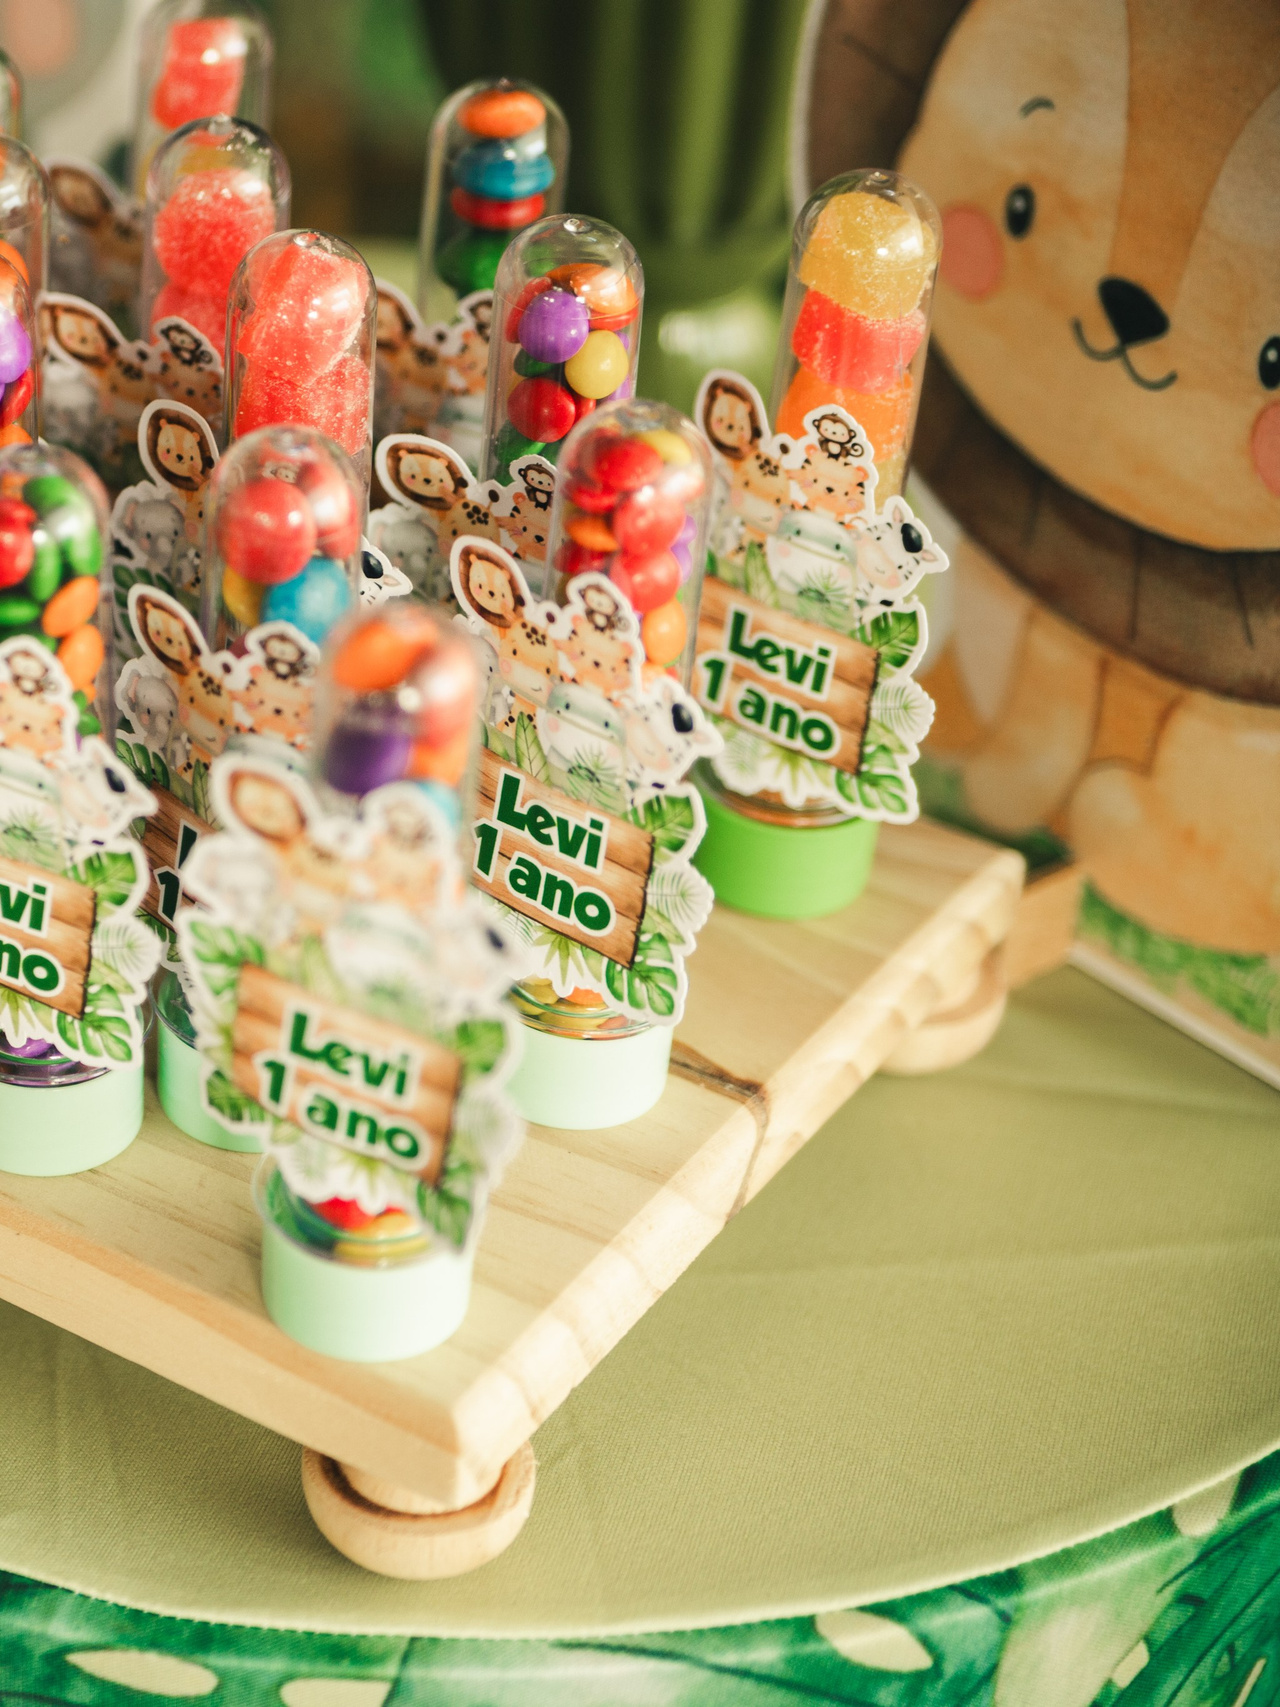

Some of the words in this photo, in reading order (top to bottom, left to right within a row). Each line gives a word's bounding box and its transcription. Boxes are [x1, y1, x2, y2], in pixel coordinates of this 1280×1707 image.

[729, 610, 830, 693] Levi
[703, 658, 725, 702] 1
[739, 688, 833, 751] ano
[497, 773, 604, 869] Levi
[474, 823, 499, 877] 1
[509, 856, 611, 931] ano
[290, 1011, 410, 1097] Levi
[263, 1059, 286, 1104] 1
[306, 1094, 419, 1159] ano
